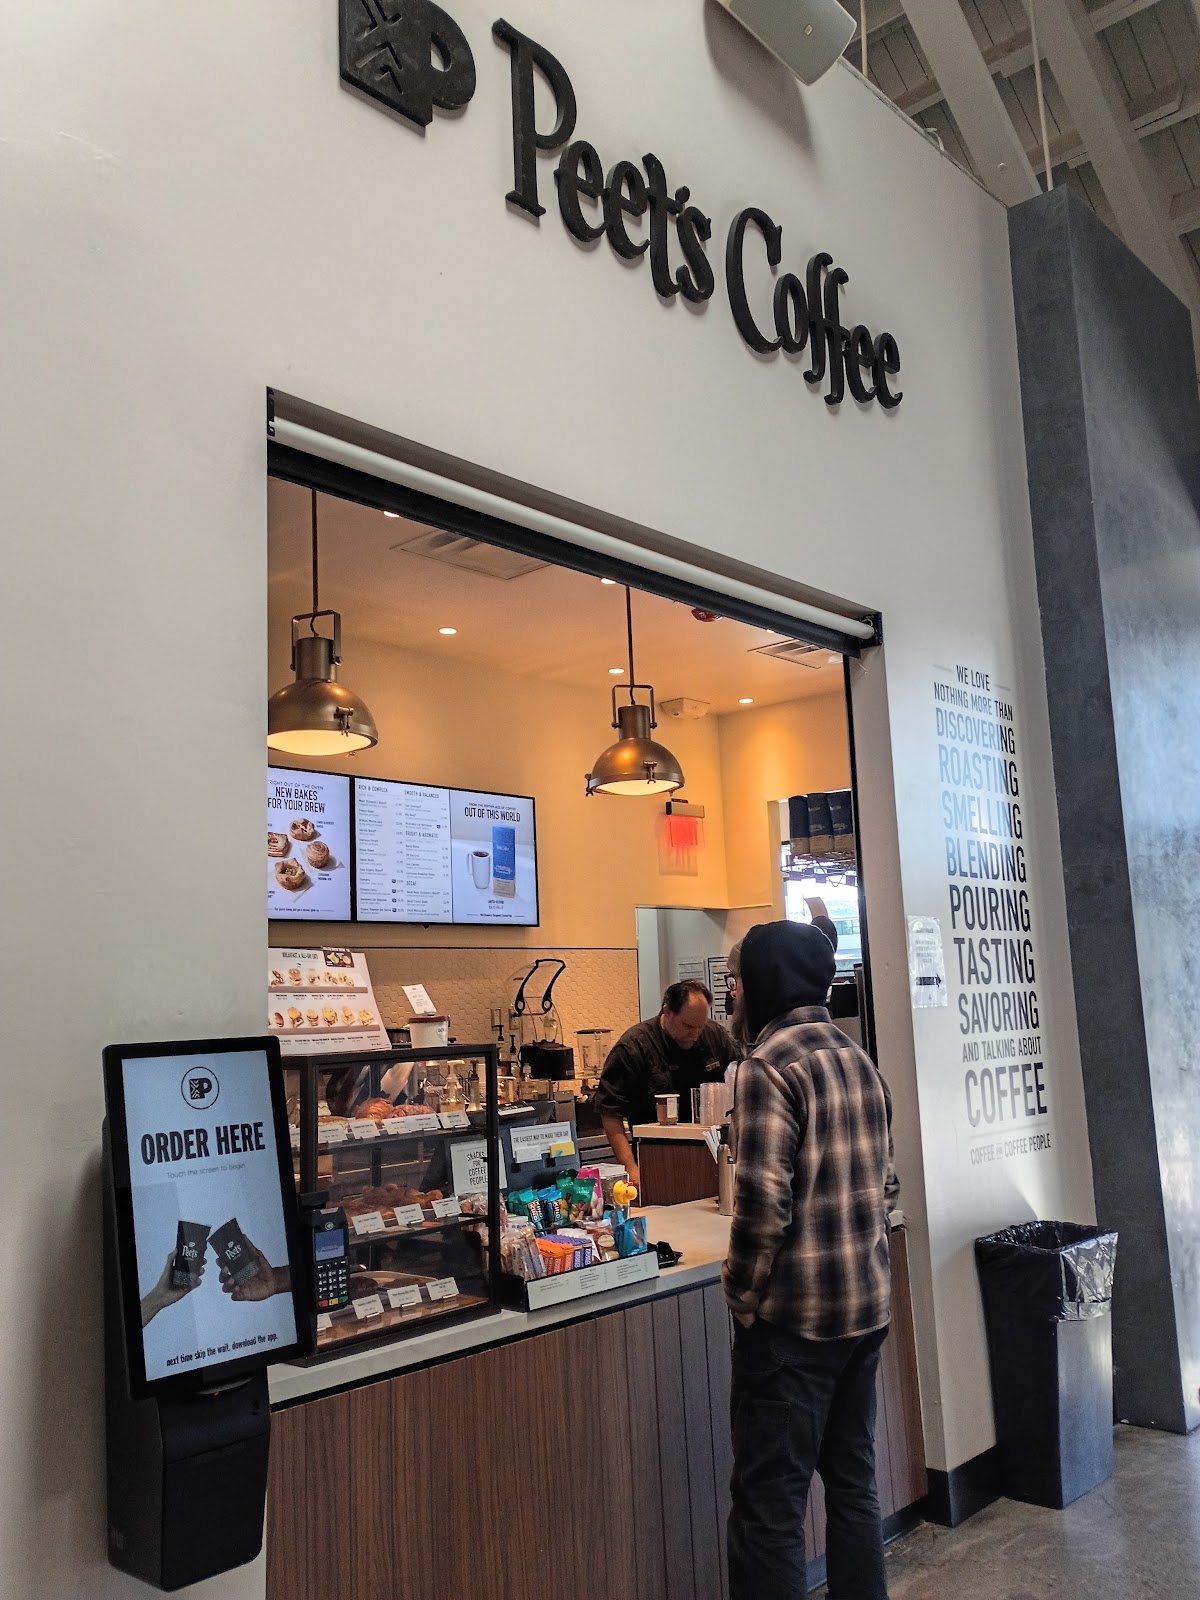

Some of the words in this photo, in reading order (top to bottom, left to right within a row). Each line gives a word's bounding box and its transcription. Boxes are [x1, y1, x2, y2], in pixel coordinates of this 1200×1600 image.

[492, 18, 715, 303] Peet's
[726, 207, 903, 408] Coffee
[956, 665, 969, 685] WE
[971, 669, 990, 691] LOVE
[934, 682, 969, 708] NOTHING
[971, 694, 992, 716] MORE
[994, 700, 1013, 722] THAN
[936, 707, 1016, 755] DISCOVERING
[938, 744, 1019, 798] ROASTING
[268, 798, 282, 809] FOR
[284, 800, 302, 811] YOUR
[305, 802, 325, 813] BREW
[276, 786, 292, 798] NEW
[295, 789, 318, 800] BAKES
[465, 807, 476, 817] OUT
[478, 808, 485, 818] OF
[487, 809, 499, 820] THIS
[501, 811, 520, 822] WORLD
[942, 790, 1023, 840] SMELLING
[945, 837, 1027, 883] BLENDING
[949, 884, 1031, 932] POURING
[953, 937, 1036, 985] TASTING
[958, 990, 1040, 1035] SAVORING
[962, 1041, 980, 1063] AND
[981, 1039, 1016, 1059] TALKING
[1018, 1036, 1041, 1056] ABOUT
[965, 1062, 1048, 1128] COFFEE
[140, 1128, 210, 1166] ORDER
[216, 1122, 266, 1156] HERE
[970, 1144, 994, 1165] COFFEE
[1004, 1138, 1027, 1157] COFFEE
[1029, 1133, 1051, 1152] PEOPLE
[200, 1167, 219, 1175] screen
[229, 1163, 245, 1173] begin
[469, 1167, 486, 1176] COFFEE
[166, 1356, 179, 1366] next
[180, 1354, 193, 1363] time
[194, 1350, 206, 1360] skip
[207, 1347, 216, 1356] the
[232, 1337, 256, 1350] download
[258, 1336, 266, 1344] the
[268, 1333, 278, 1342] app.
